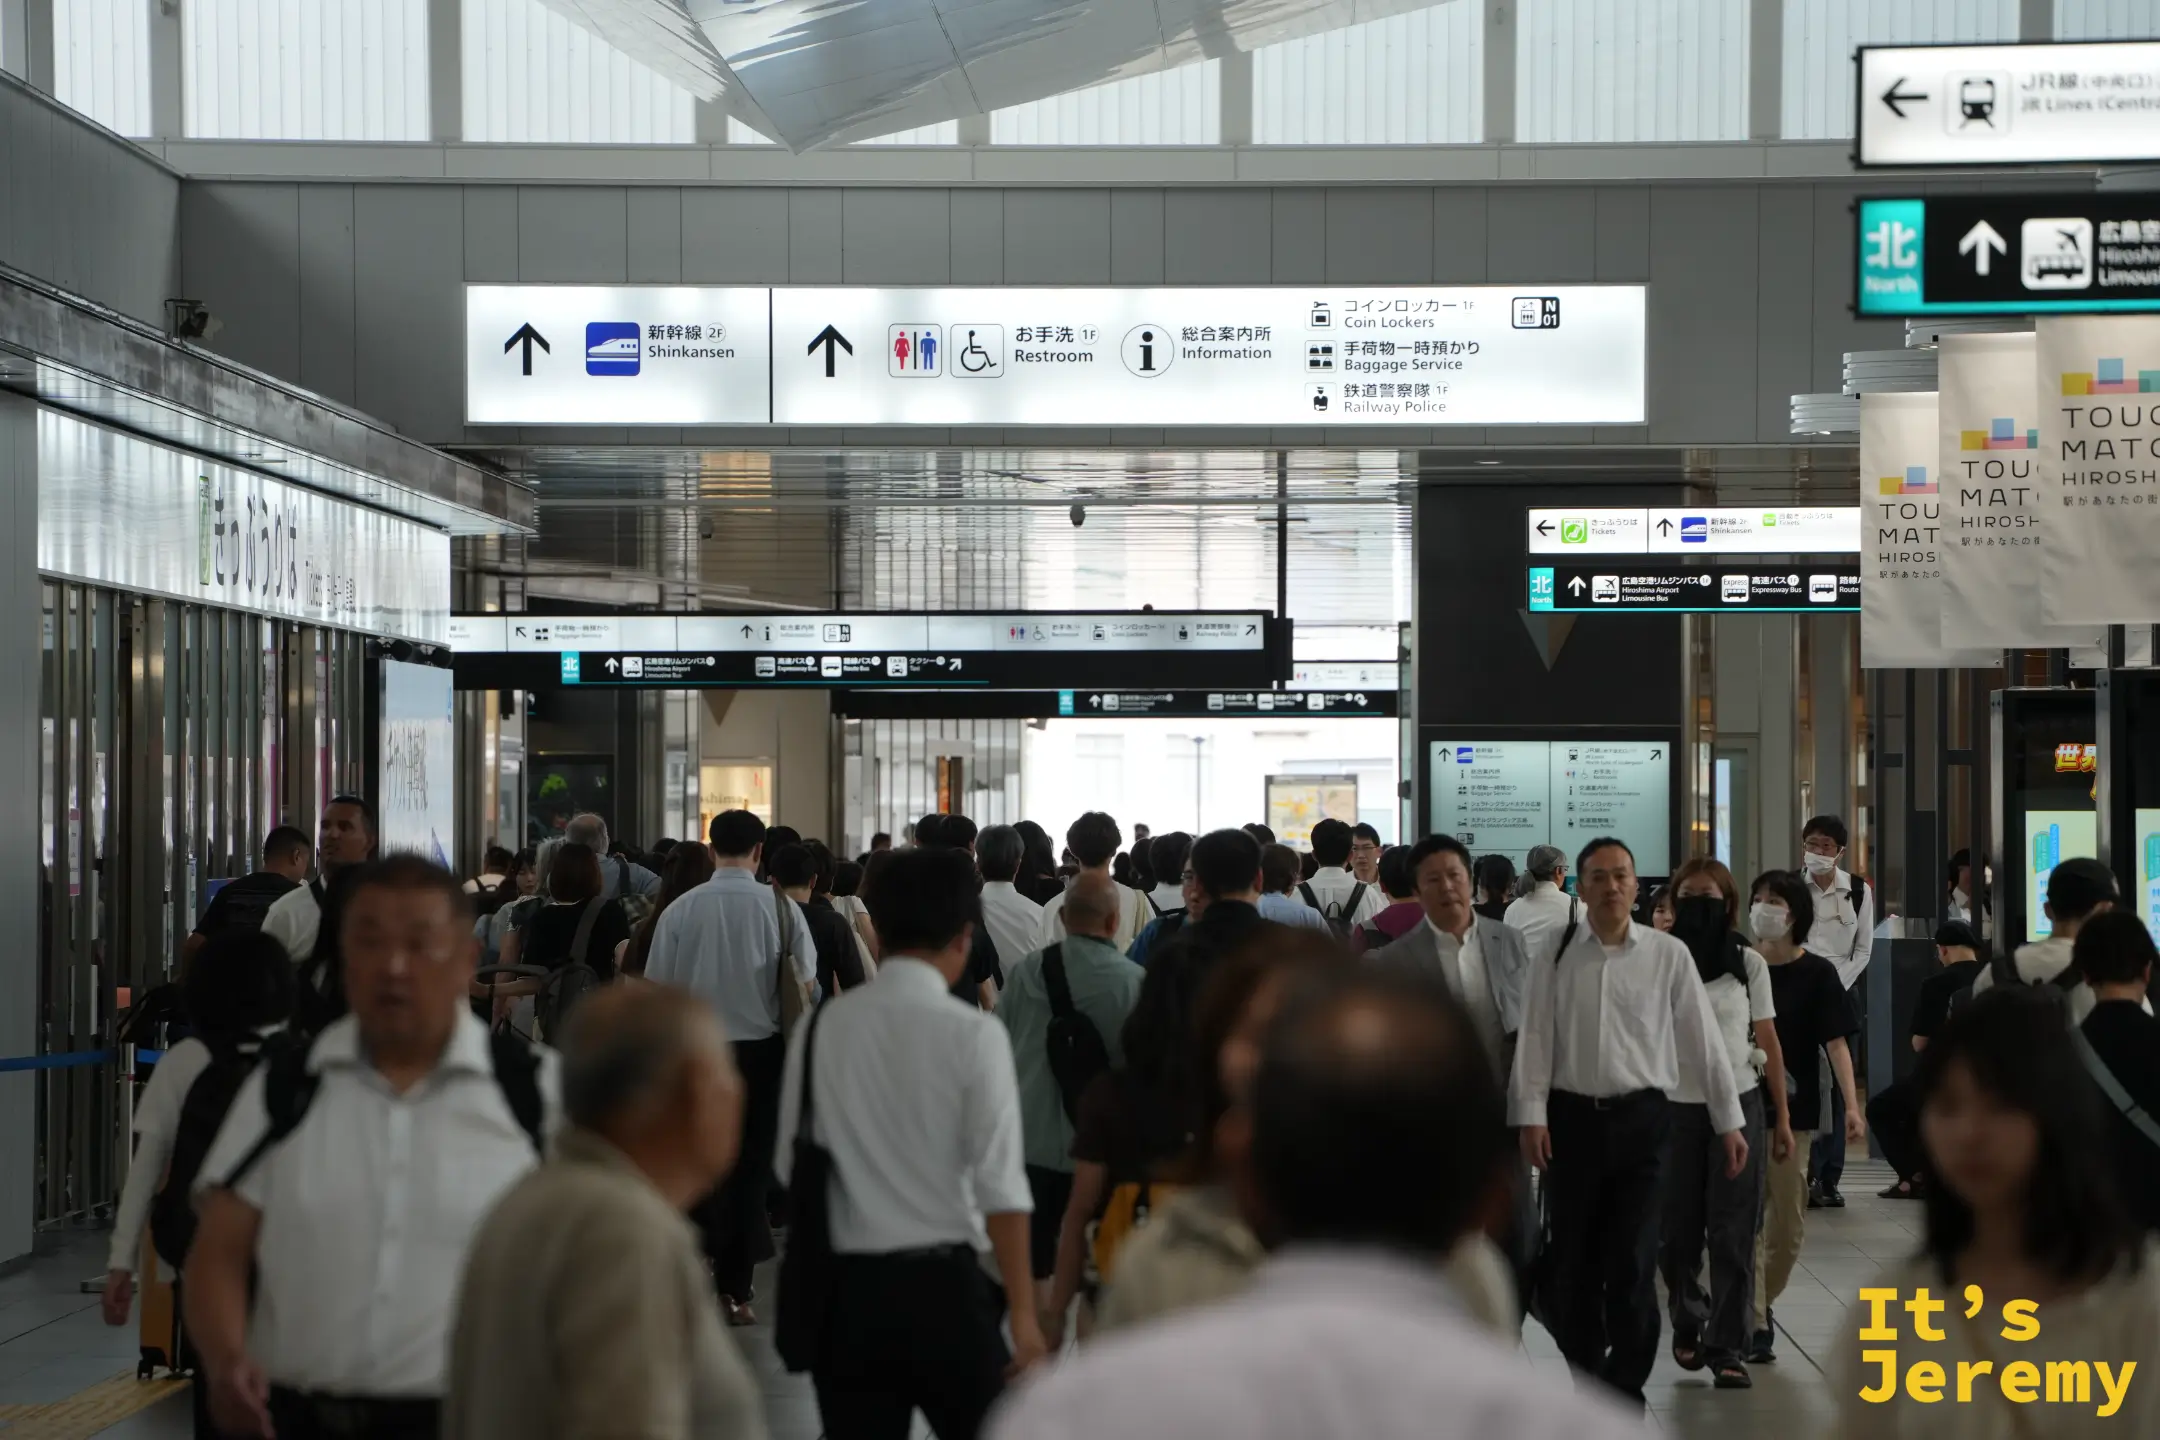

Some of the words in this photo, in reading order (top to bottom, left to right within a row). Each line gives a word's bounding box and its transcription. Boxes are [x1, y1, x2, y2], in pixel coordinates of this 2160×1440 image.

[1866, 221, 1917, 269] 北
[1344, 299, 1457, 312] コインロッカー
[1545, 301, 1557, 312] N
[1345, 316, 1376, 328] Coin
[1381, 316, 1435, 328] Lockers
[1543, 314, 1558, 326] 01
[648, 324, 702, 341] 新幹線
[709, 327, 723, 339] 2F
[1016, 326, 1075, 343] お手洗
[1082, 329, 1096, 340] 1F
[1182, 325, 1271, 341] 総合案内所
[648, 345, 735, 358] Shinkansen
[1182, 345, 1272, 359] Information
[1344, 340, 1480, 356] 手荷物一時預かり
[1015, 349, 1093, 362] Restroom
[1345, 359, 1408, 373] Baggage
[1412, 358, 1463, 371] Service
[1344, 383, 1431, 399] 鉄道警察隊
[1436, 385, 1449, 395] 1F
[1344, 401, 1400, 415] Railway
[1405, 401, 1446, 413] Police
[1961, 460, 2039, 479] TOU
[2062, 469, 2156, 486] HIROSH
[1961, 487, 2039, 507] MAT
[2063, 494, 2158, 506] 駅があなたの街
[214, 486, 298, 601] きっぷうりば
[1879, 551, 1940, 563] HIROS
[1532, 575, 1552, 593] 北
[1723, 578, 1748, 586] Express
[1622, 586, 1655, 594] Hiroshima
[1657, 586, 1680, 595] Airport
[1751, 586, 1789, 594] Expressway
[1622, 594, 1654, 602] Limousine
[1656, 594, 1669, 602] Bus
[563, 657, 578, 672] 北
